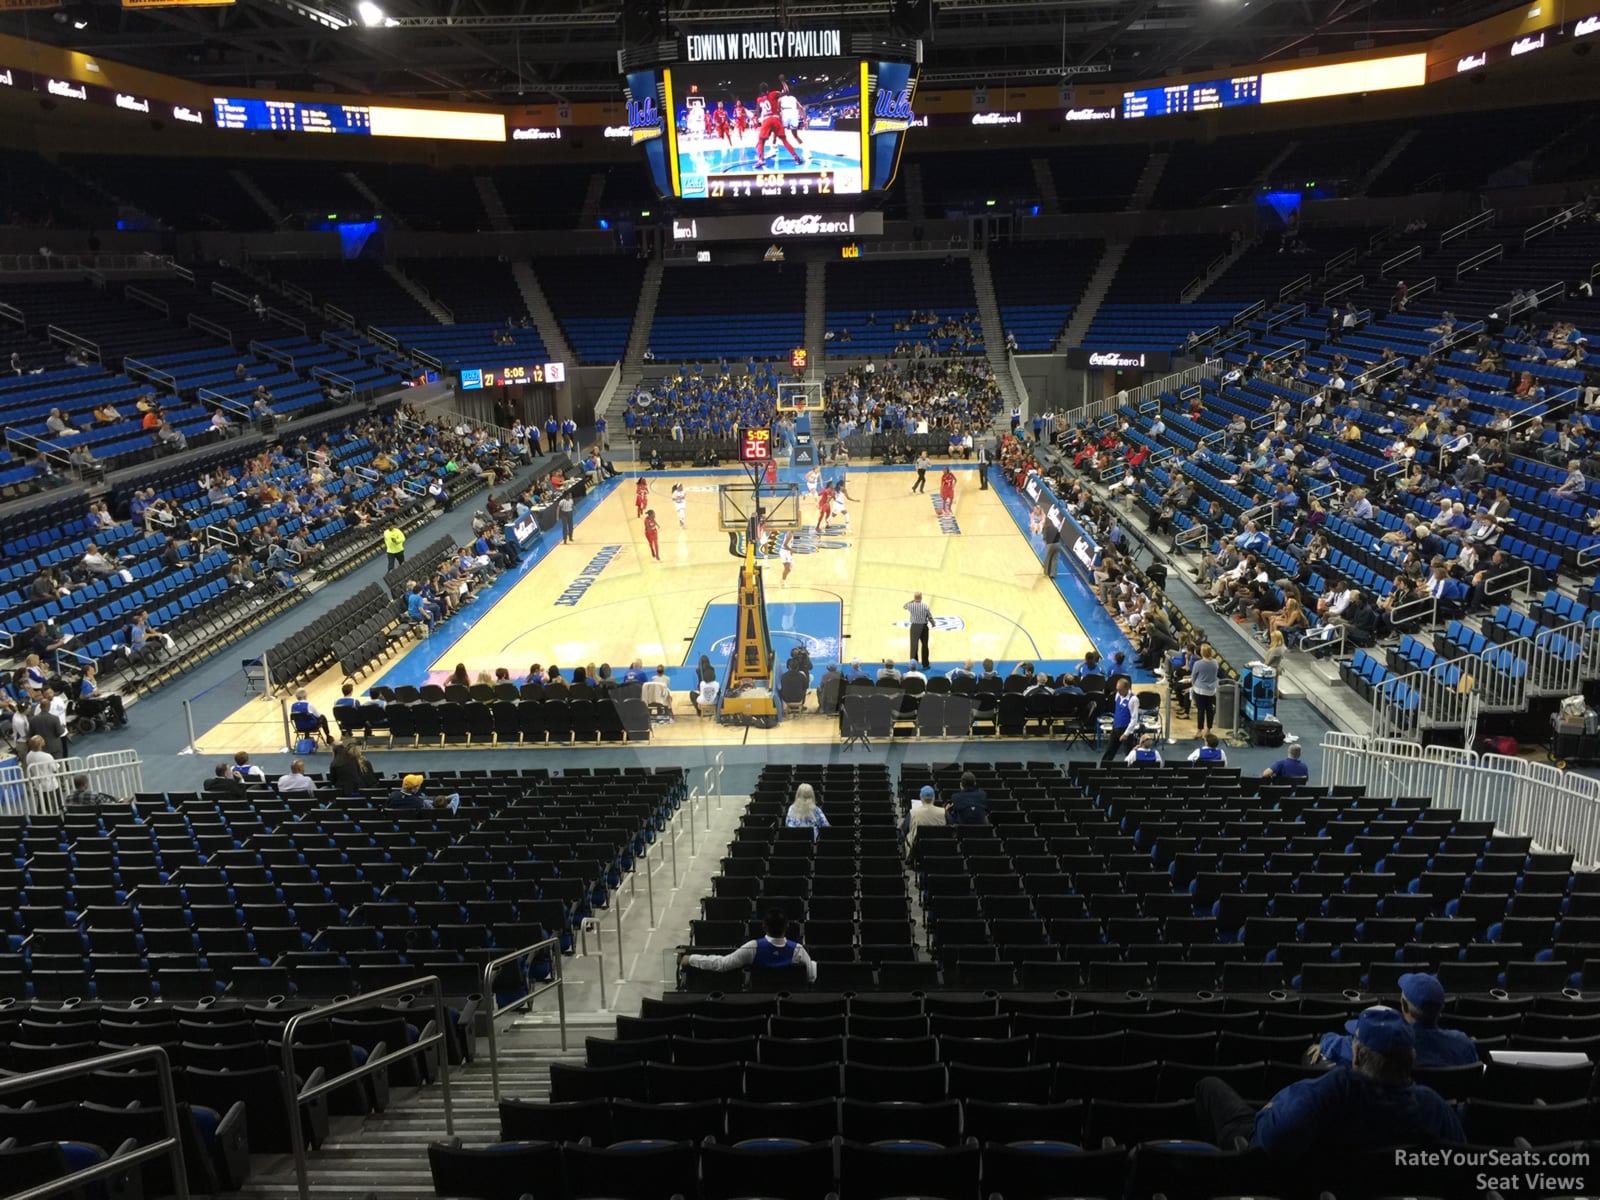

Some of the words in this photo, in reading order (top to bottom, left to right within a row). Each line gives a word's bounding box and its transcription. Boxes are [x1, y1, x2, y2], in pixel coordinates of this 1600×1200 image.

[687, 34, 725, 61] EDWIN
[727, 33, 739, 60] W
[742, 31, 784, 59] PAULEY
[788, 30, 841, 57] PAVILION
[711, 181, 725, 197] 27
[817, 178, 830, 194] 12
[793, 356, 805, 366] 26
[485, 374, 494, 386] 27
[533, 370, 543, 382] 12
[747, 430, 770, 441] 5:05
[745, 441, 767, 458] 26
